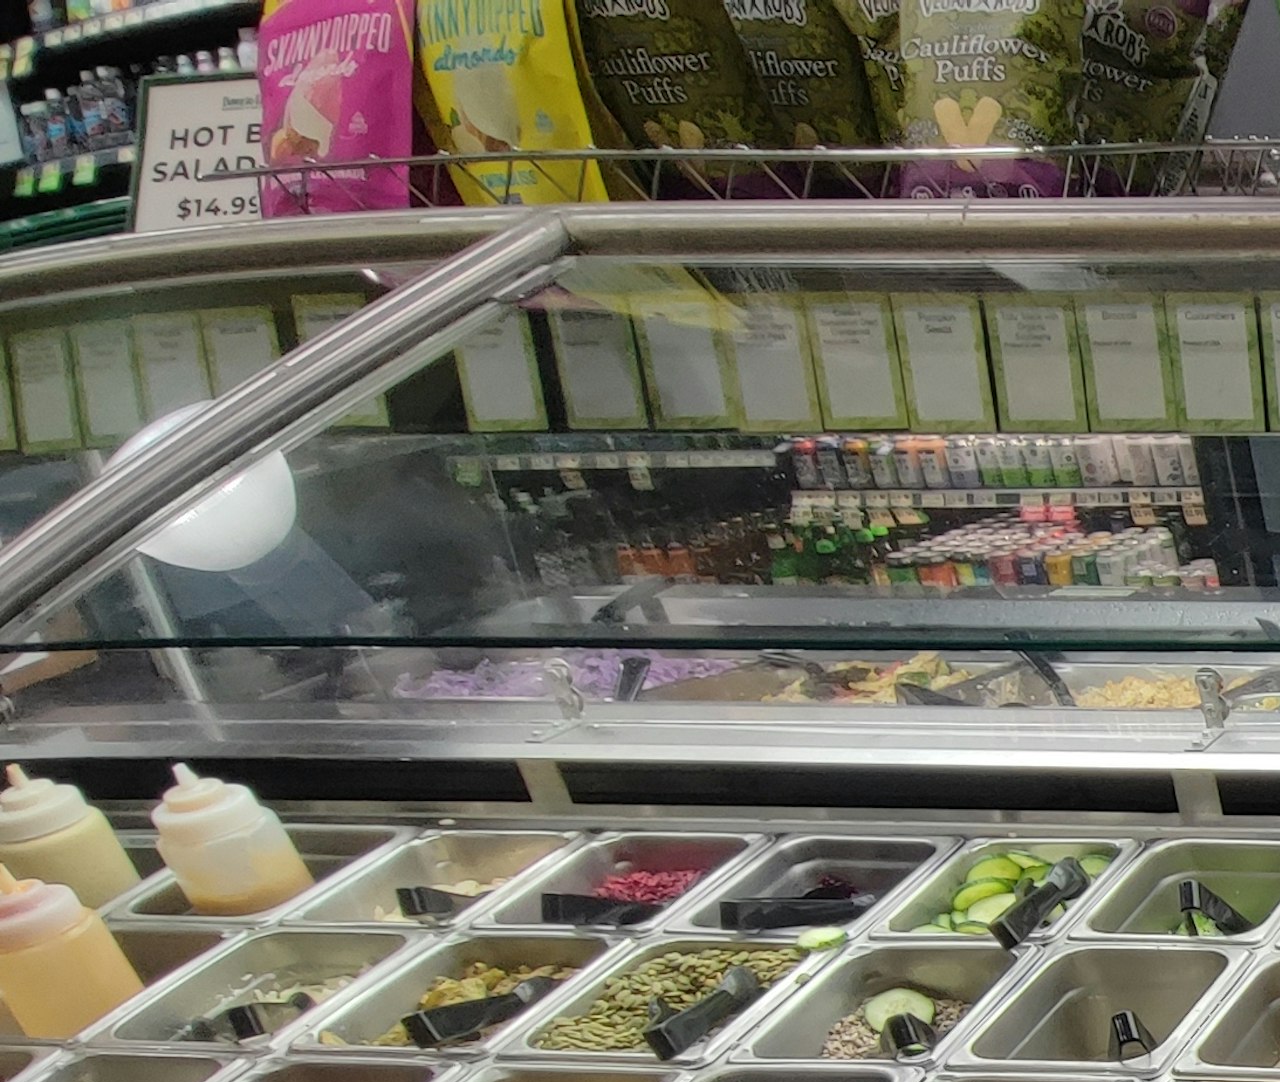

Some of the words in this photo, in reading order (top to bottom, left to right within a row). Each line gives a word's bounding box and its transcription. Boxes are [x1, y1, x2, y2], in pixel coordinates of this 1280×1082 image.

[264, 12, 392, 77] SKINNYDIPPED
[901, 33, 1049, 64] Cauliflower
[935, 57, 1006, 83] Puffs
[622, 77, 689, 105] Puffs
[170, 125, 235, 150] HOT
[1185, 310, 1235, 320] Cucumbers
